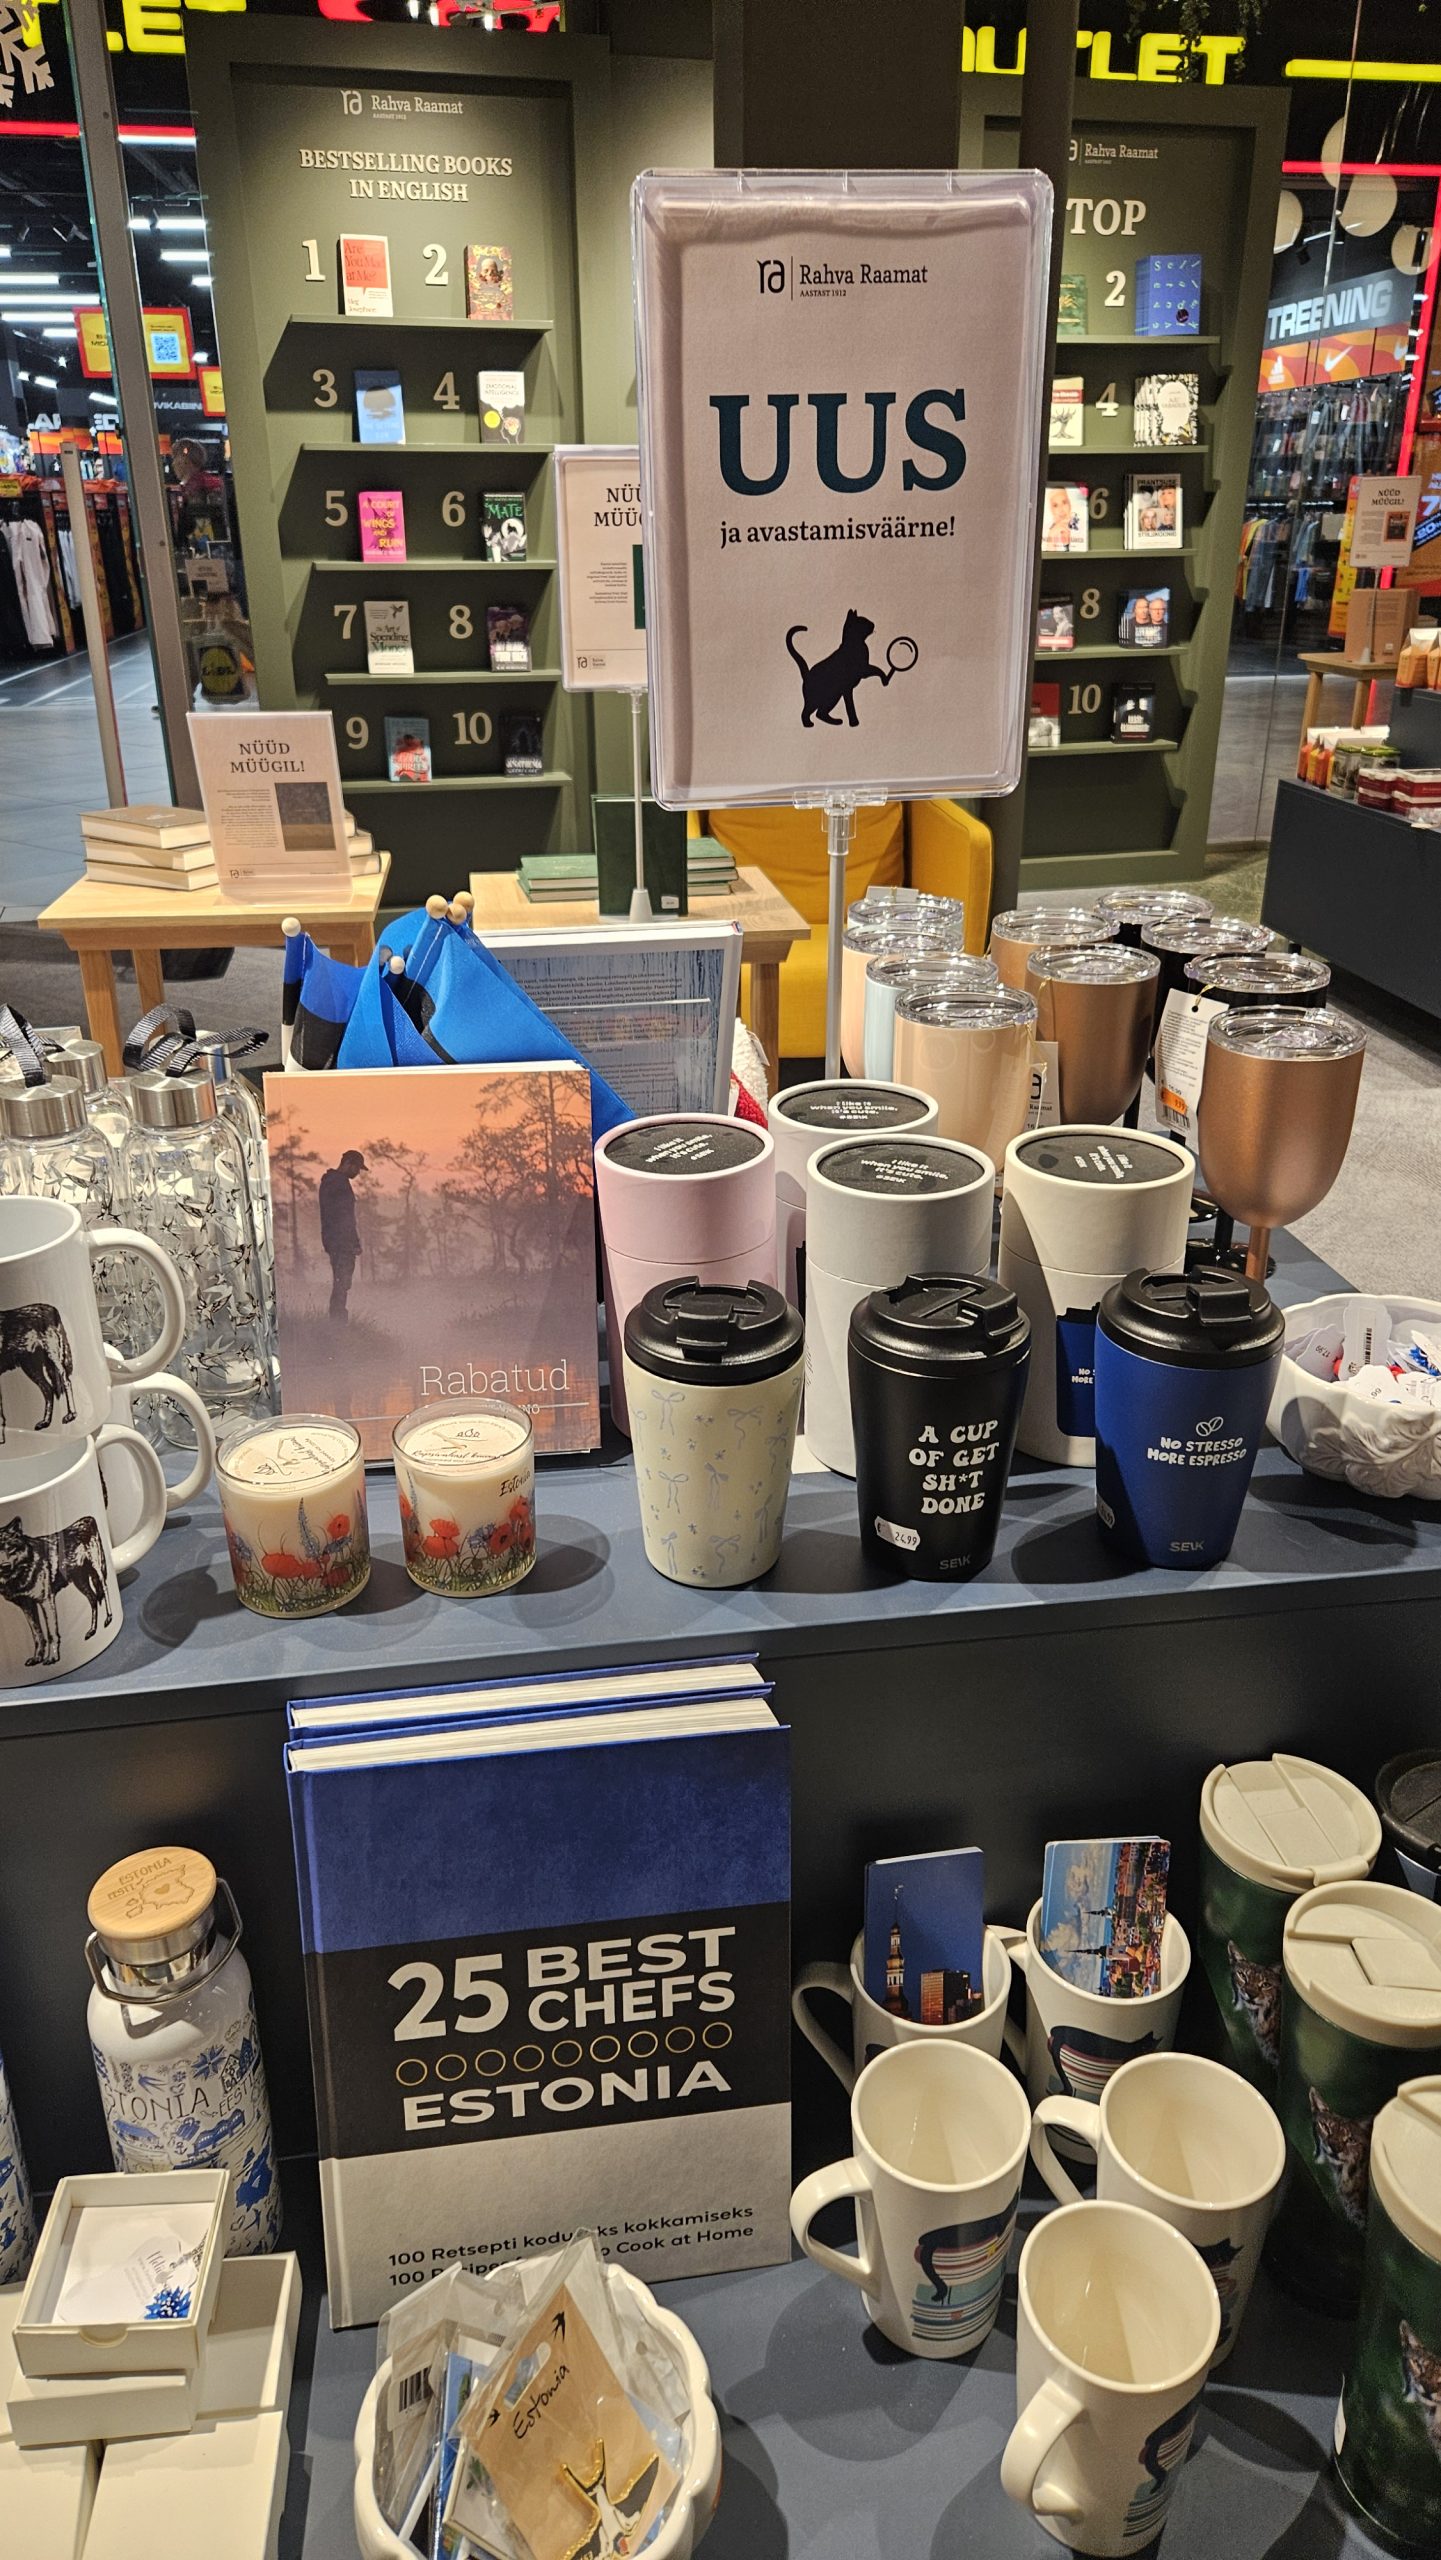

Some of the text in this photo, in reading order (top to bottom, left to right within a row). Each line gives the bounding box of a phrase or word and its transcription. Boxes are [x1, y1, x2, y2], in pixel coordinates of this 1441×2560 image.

[371, 95, 411, 112] Rahva
[414, 97, 463, 114] Raamat
[299, 149, 513, 177] BESTSELLING BOOKS
[1085, 143, 1158, 159] Rahva Raamat
[349, 179, 469, 202] IN ENGLISH
[1066, 198, 1147, 236] TOP
[302, 239, 326, 282] 1
[423, 243, 449, 285] 2
[800, 263, 855, 285] Rahva
[860, 263, 928, 284] Raamat
[832, 289, 847, 297] 1912
[1105, 270, 1127, 307] 2
[1268, 279, 1394, 341] TREENING
[312, 369, 338, 408] 3
[433, 371, 460, 410] 4
[1096, 382, 1119, 417] 4
[709, 388, 967, 496] UUS
[325, 490, 348, 527] 5
[442, 491, 466, 527] 6
[485, 502, 524, 519] MATE
[1089, 488, 1110, 520] 6
[720, 516, 955, 549] ja avastamisväärne!
[1080, 588, 1101, 619] 8
[334, 604, 357, 640] 7
[449, 604, 474, 640] 8
[1068, 684, 1101, 715] 10
[345, 717, 369, 749] 9
[452, 711, 492, 745] 10
[239, 739, 291, 756] NÜÜD
[230, 758, 306, 774] MÜÜGIL!
[861, 1160, 891, 1168] when
[419, 1359, 570, 1396] Rabatud
[1071, 1376, 1094, 1384] MORE
[918, 1420, 999, 1444] A CUP
[1160, 1437, 1244, 1453] NO STRESSO
[908, 1442, 1000, 1467] OF GET
[1147, 1448, 1247, 1466] MORE ESPRESSO
[921, 1492, 986, 1515] DONE
[119, 1857, 173, 1886] ESTONIA
[387, 1926, 736, 2042] 25 BEST
[528, 1970, 735, 2032] CHEFS
[403, 2060, 732, 2131] ESTONIA
[388, 2251, 425, 2266] 100
[432, 2237, 517, 2261] Retsepti
[624, 2207, 753, 2233] kokkamiseks
[389, 2270, 425, 2286] 100
[616, 2238, 665, 2254] Cook
[671, 2234, 691, 2247] at
[697, 2227, 754, 2243] Home
[512, 2362, 571, 2440] Estonia
